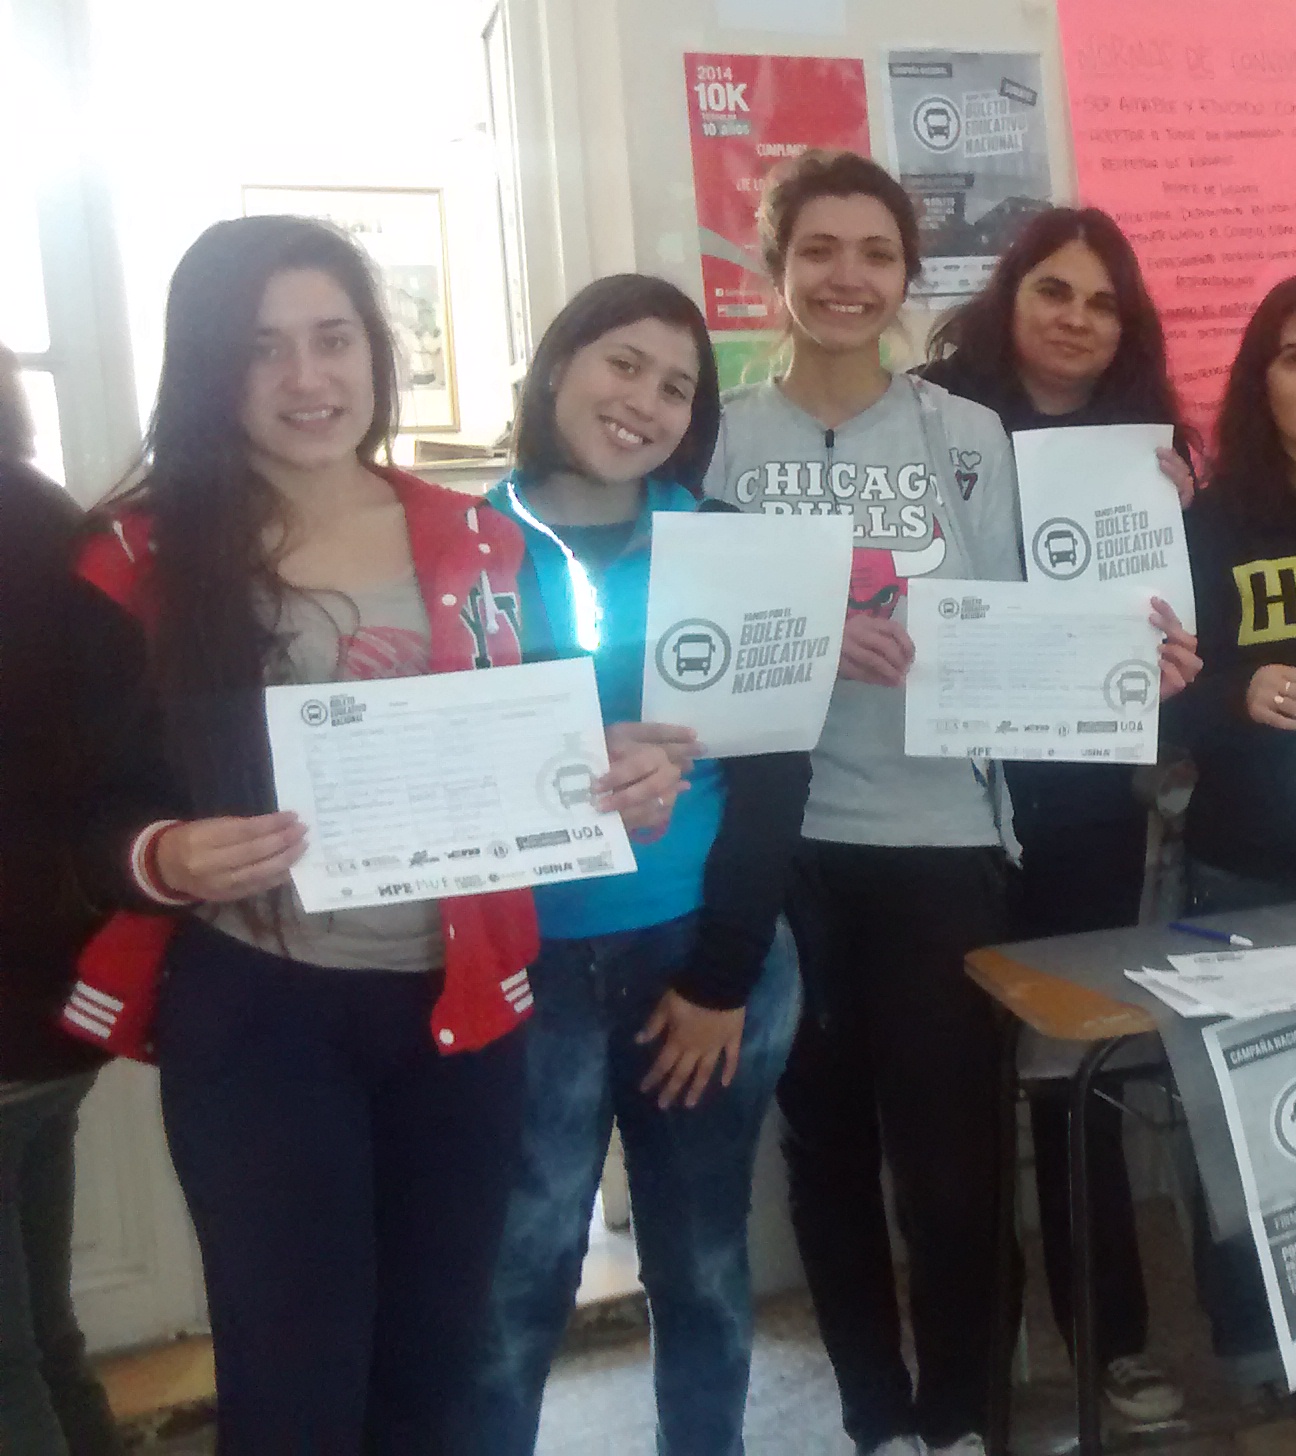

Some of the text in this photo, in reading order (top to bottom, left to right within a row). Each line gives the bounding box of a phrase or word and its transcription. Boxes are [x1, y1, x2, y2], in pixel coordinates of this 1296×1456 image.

[697, 66, 733, 80] 2014
[694, 82, 750, 112] 10K
[1095, 510, 1149, 539] BOLETO
[1096, 526, 1174, 561] EDUCATIVO
[1098, 550, 1168, 581] NACIONAL
[740, 617, 807, 646] BOLETO
[735, 636, 830, 671] EDUCATIVO
[731, 662, 813, 695] NACIONAL
[1229, 1039, 1275, 1065] CAMPAÑA
